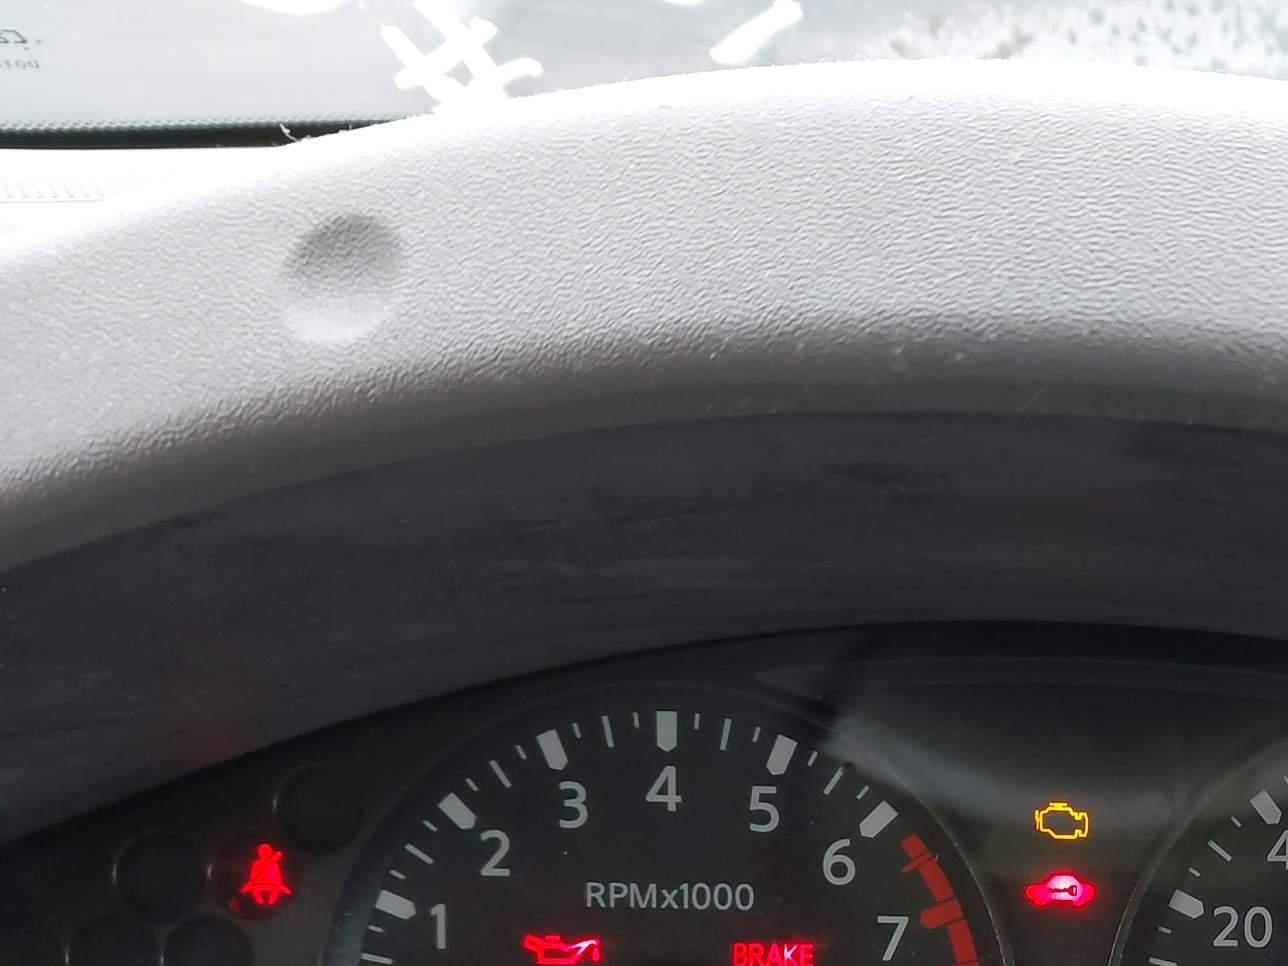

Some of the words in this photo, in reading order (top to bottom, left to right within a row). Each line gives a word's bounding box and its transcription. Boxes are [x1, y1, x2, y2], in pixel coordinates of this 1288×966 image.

[559, 781, 588, 829] 3
[645, 766, 682, 812] 4
[750, 786, 780, 833] 5
[480, 830, 512, 877] 2
[822, 838, 857, 886] 6
[586, 881, 756, 911] RPMx1000
[429, 903, 447, 950] 1
[877, 915, 910, 961] 7
[1212, 906, 1273, 948] 20
